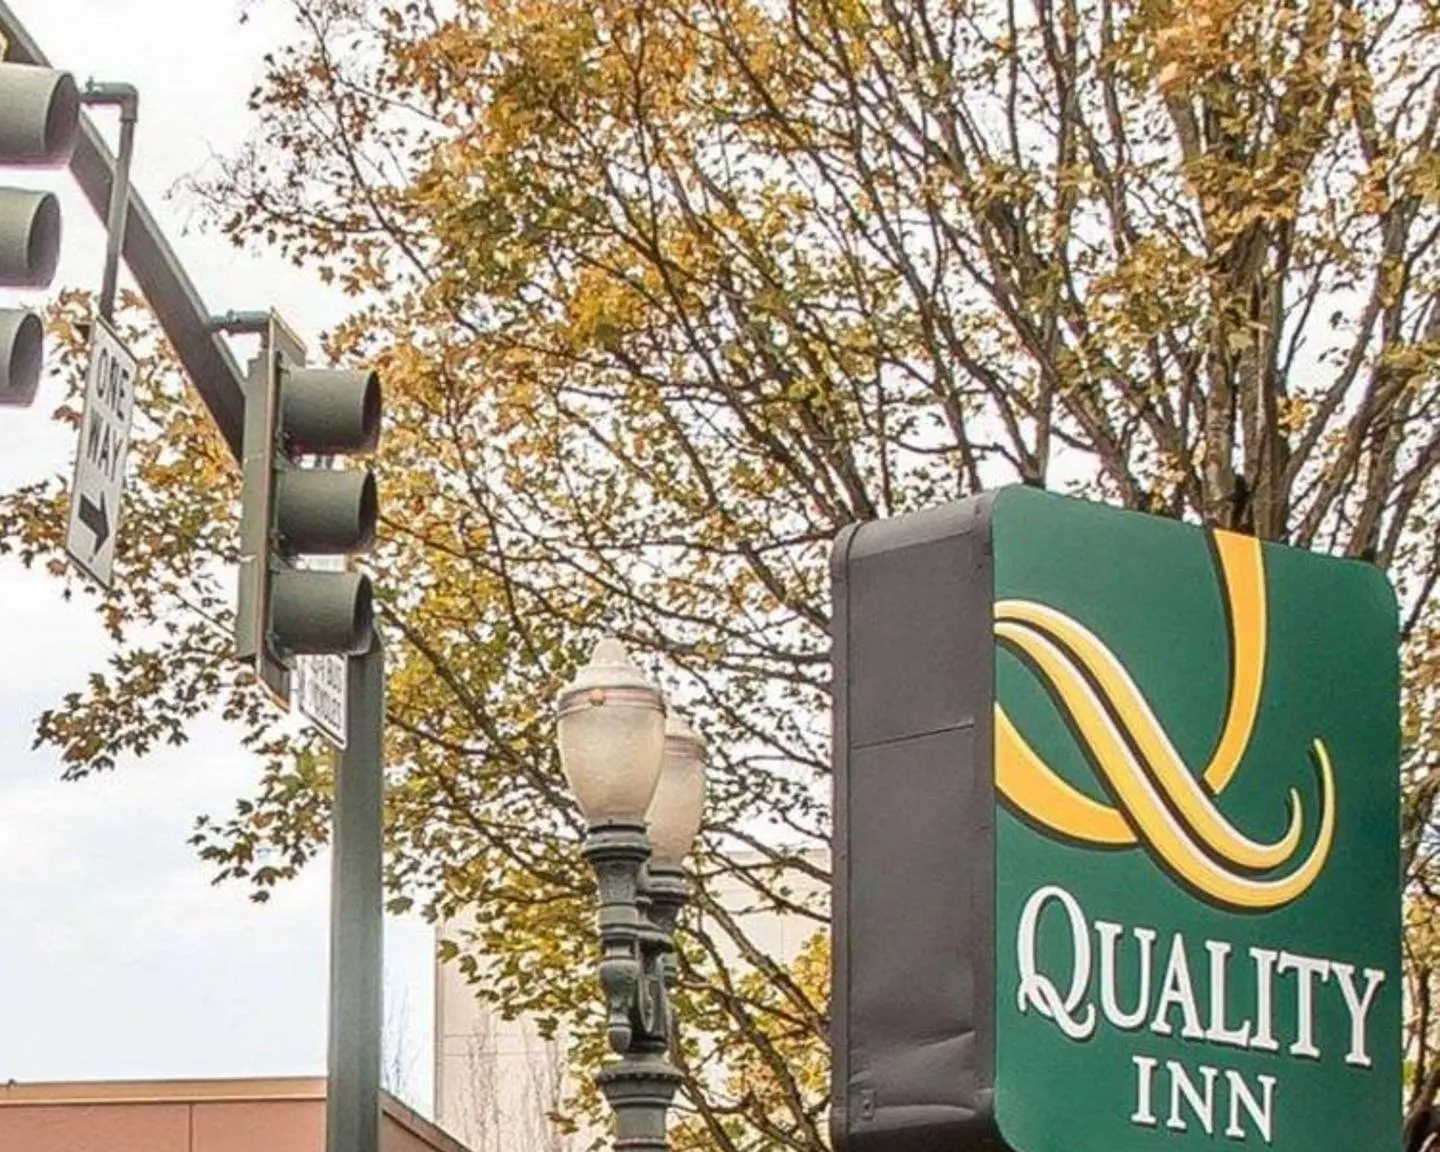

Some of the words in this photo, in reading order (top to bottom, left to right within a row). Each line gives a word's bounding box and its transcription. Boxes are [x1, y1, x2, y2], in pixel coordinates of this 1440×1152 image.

[96, 347, 129, 421] ONE
[87, 406, 123, 483] WAY
[1016, 885, 1386, 1067] QUALITY
[1131, 1054, 1277, 1143] INN
